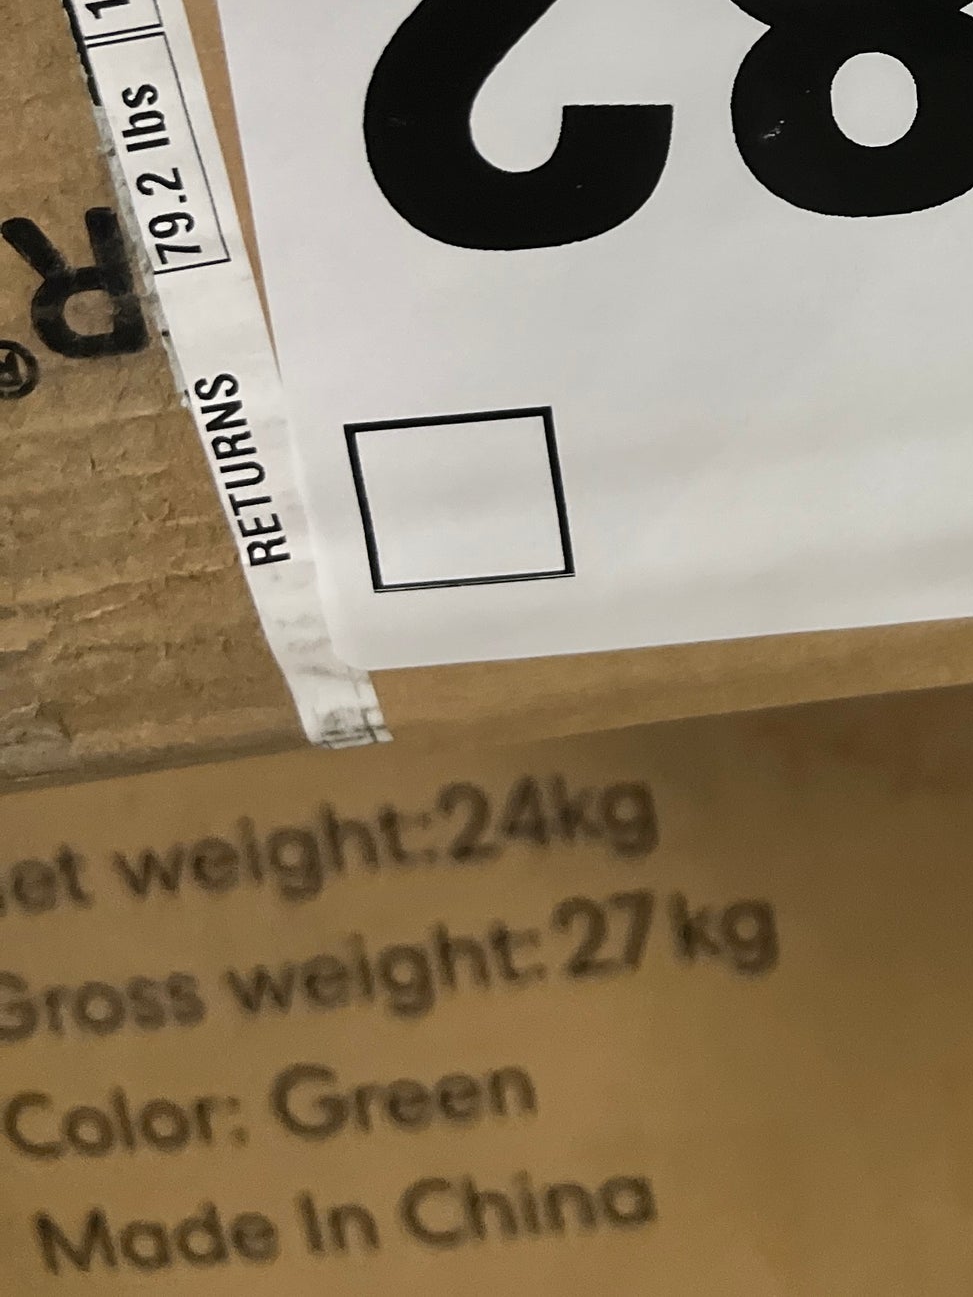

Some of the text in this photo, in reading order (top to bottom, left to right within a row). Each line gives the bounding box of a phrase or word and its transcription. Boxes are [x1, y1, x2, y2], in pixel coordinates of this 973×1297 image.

[121, 81, 203, 266] 79.2 lbs
[194, 371, 292, 566] RETURNS
[0, 842, 90, 915] et
[0, 970, 207, 1042] Gross
[3, 1061, 537, 1160] Color: Green
[33, 1170, 660, 1275] Made In China
